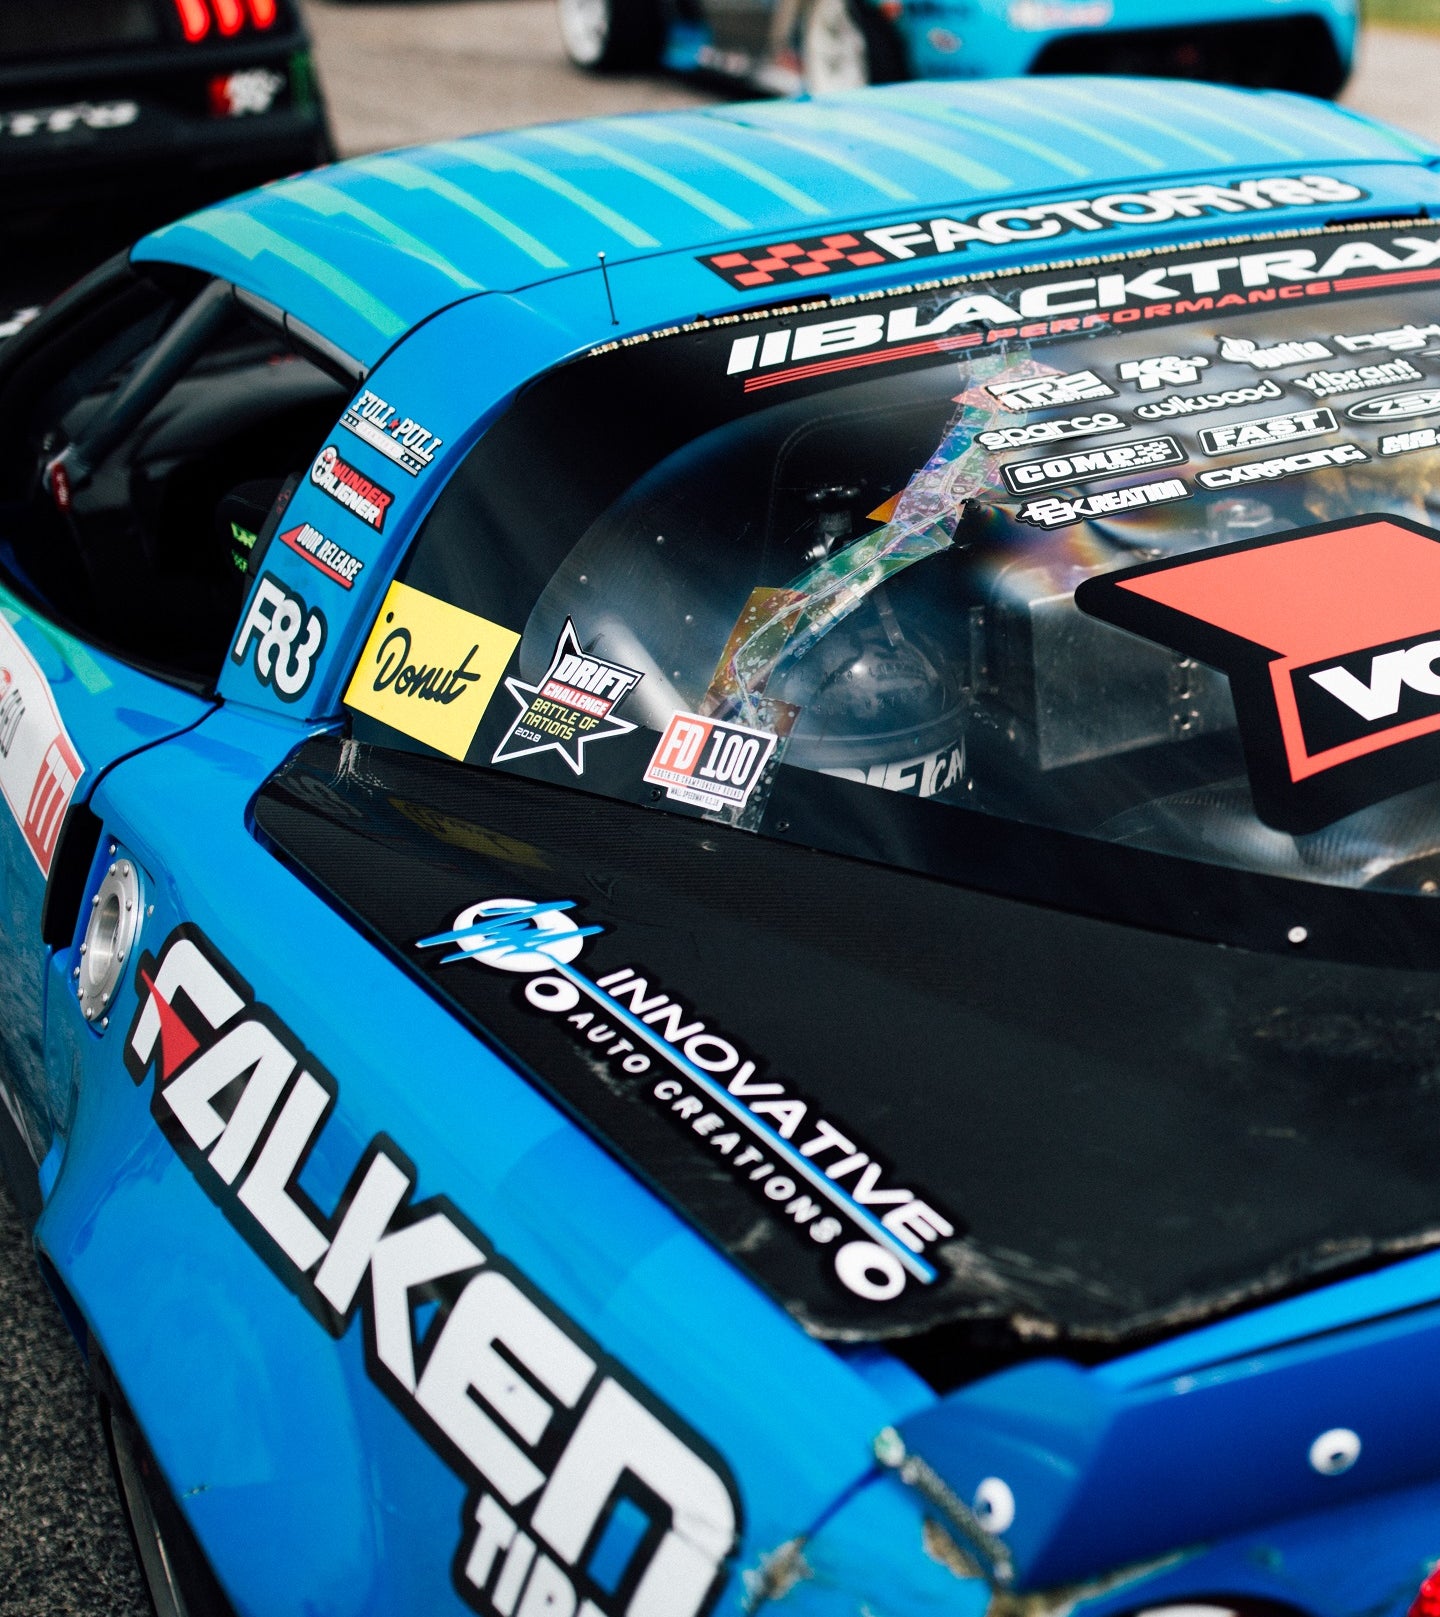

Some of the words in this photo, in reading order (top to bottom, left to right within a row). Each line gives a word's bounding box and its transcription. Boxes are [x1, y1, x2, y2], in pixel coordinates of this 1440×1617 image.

[870, 177, 1363, 259] FACTORY83
[983, 281, 1334, 342] PERFORMANCE
[1120, 356, 1209, 392] K&N
[1294, 359, 1416, 390] vibrant
[352, 390, 396, 430] FULL
[391, 418, 443, 462] PULL
[978, 413, 1121, 450] sparco
[1211, 412, 1320, 448] FAST
[332, 458, 391, 513] WUNDER
[1014, 447, 1137, 484] COMP
[1200, 444, 1368, 488] CXRACING
[319, 473, 381, 525] ALIGNER
[296, 523, 321, 553] DOOR
[316, 538, 364, 582] RELEASE
[235, 578, 321, 694] F83
[373, 626, 481, 705] Donut
[552, 653, 636, 700] DRIFT
[522, 712, 576, 740] NATIONS
[530, 698, 580, 725] BATTLE
[578, 716, 600, 731] OF
[543, 683, 610, 716] CHALLENGE
[514, 727, 542, 742] 2018
[660, 720, 704, 770] FD
[700, 730, 760, 785] 100
[567, 1011, 651, 1074] AUTO
[653, 1079, 843, 1245] CREATIONS
[596, 967, 955, 1254] INNOVATIVE
[131, 938, 735, 1617] FALKEN
[466, 1493, 610, 1617] TIR
